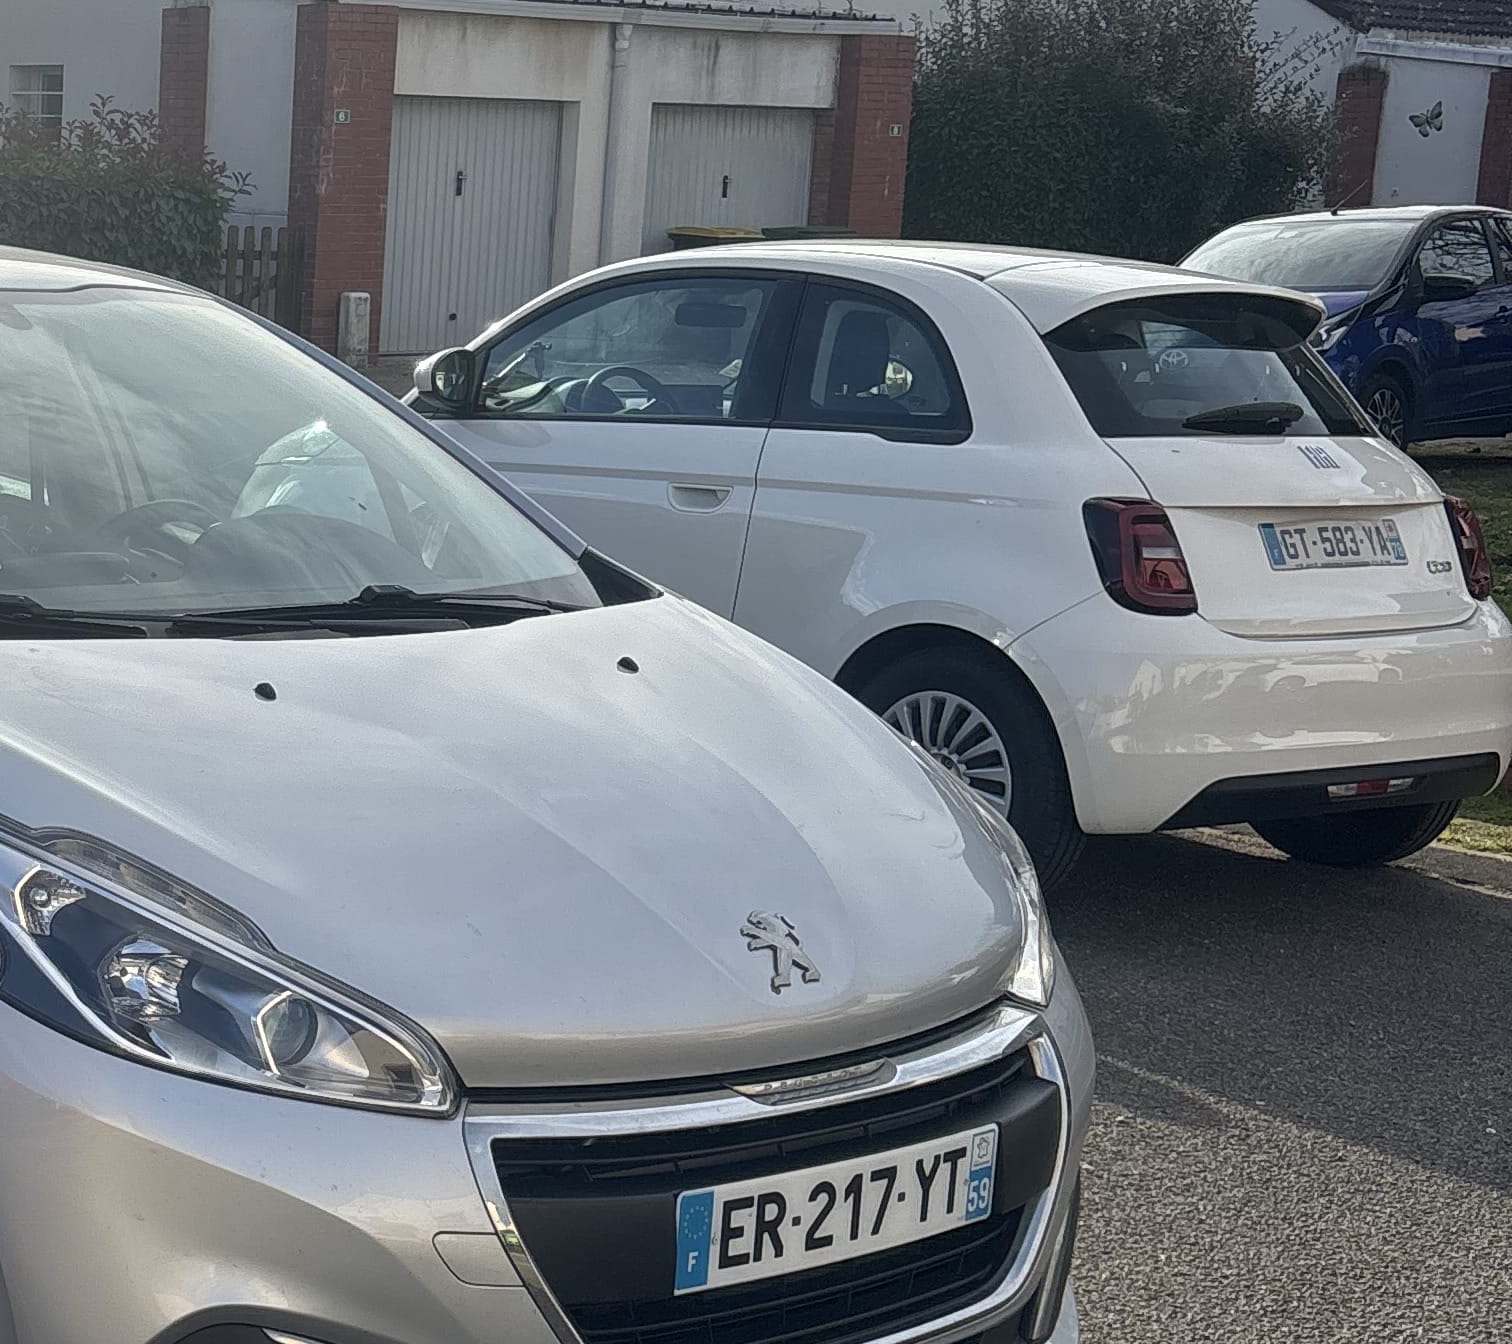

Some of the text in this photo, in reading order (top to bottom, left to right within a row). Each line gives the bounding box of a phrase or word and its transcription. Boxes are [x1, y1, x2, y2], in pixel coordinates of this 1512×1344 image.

[338, 111, 345, 121] 6
[1279, 526, 1391, 559] GT-583-YA
[687, 1147, 990, 1272] F ER-217-YT 59
